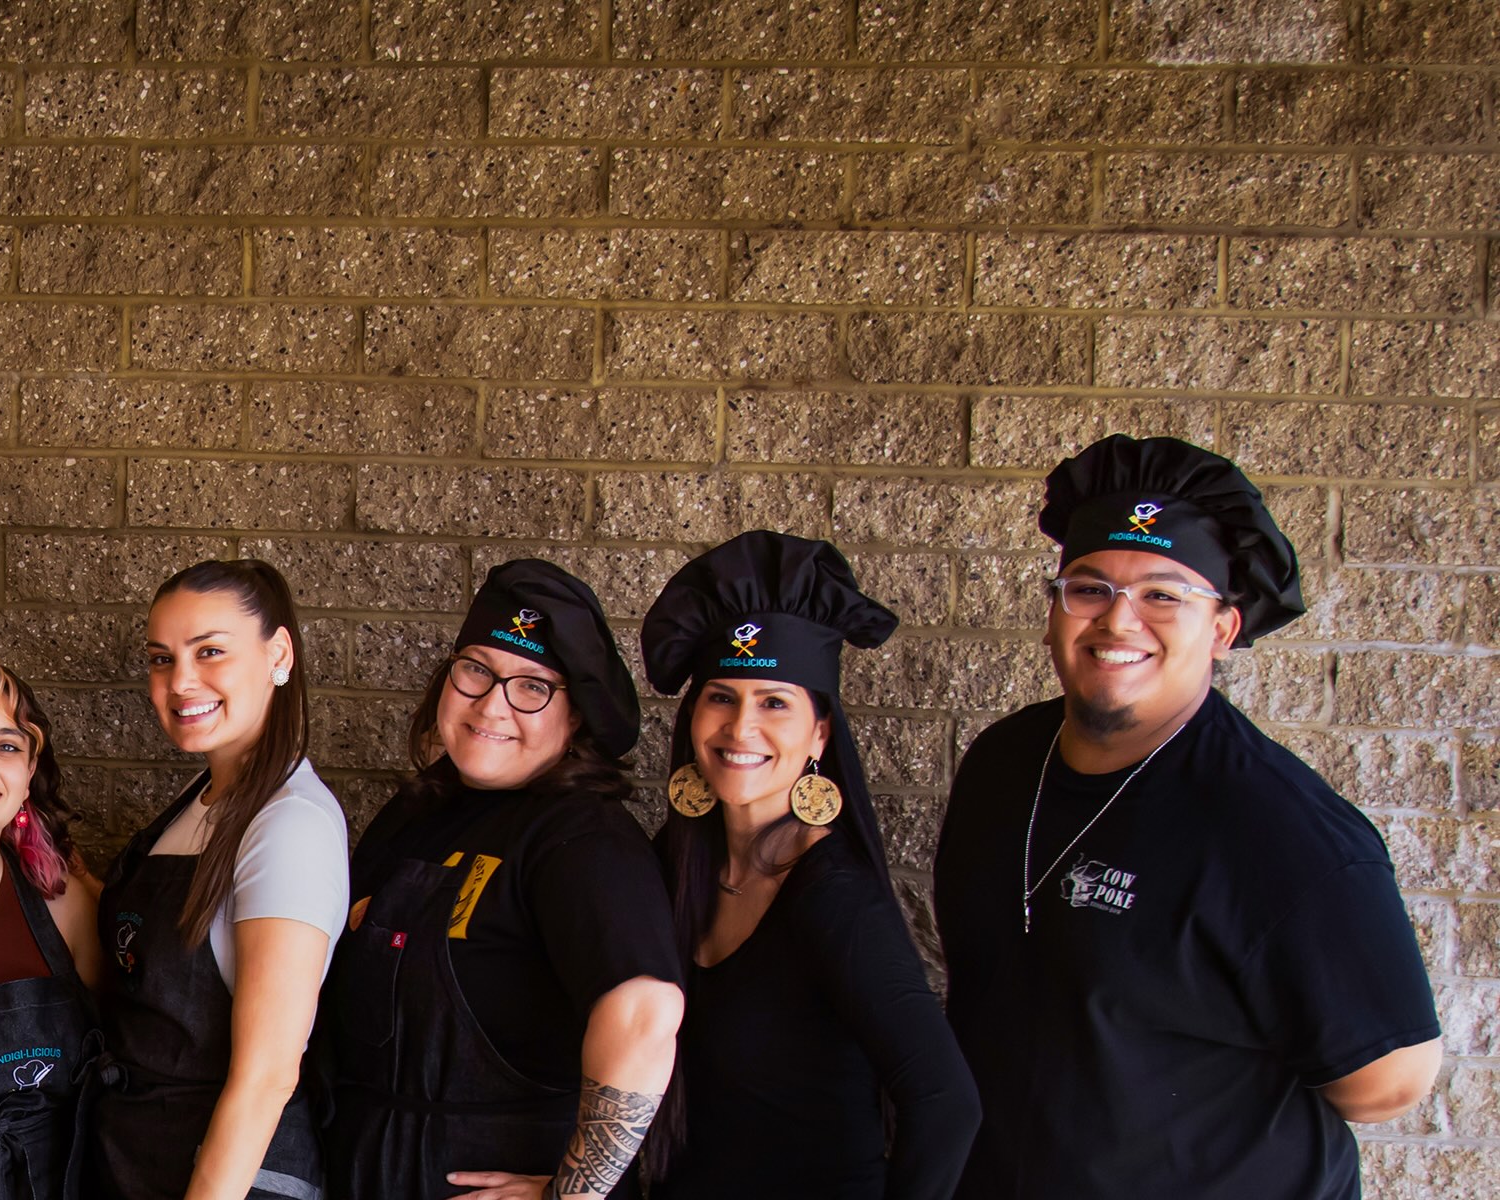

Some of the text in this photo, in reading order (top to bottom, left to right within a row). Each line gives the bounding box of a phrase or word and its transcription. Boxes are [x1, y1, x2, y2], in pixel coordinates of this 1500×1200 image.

[1107, 532, 1172, 549] INDIGI-LICIOUS
[490, 629, 545, 655] INDIGI-LICIOUS
[719, 657, 777, 668] INDIGI-LICIOUS
[1102, 867, 1136, 889] COW
[1093, 884, 1136, 909] POKE
